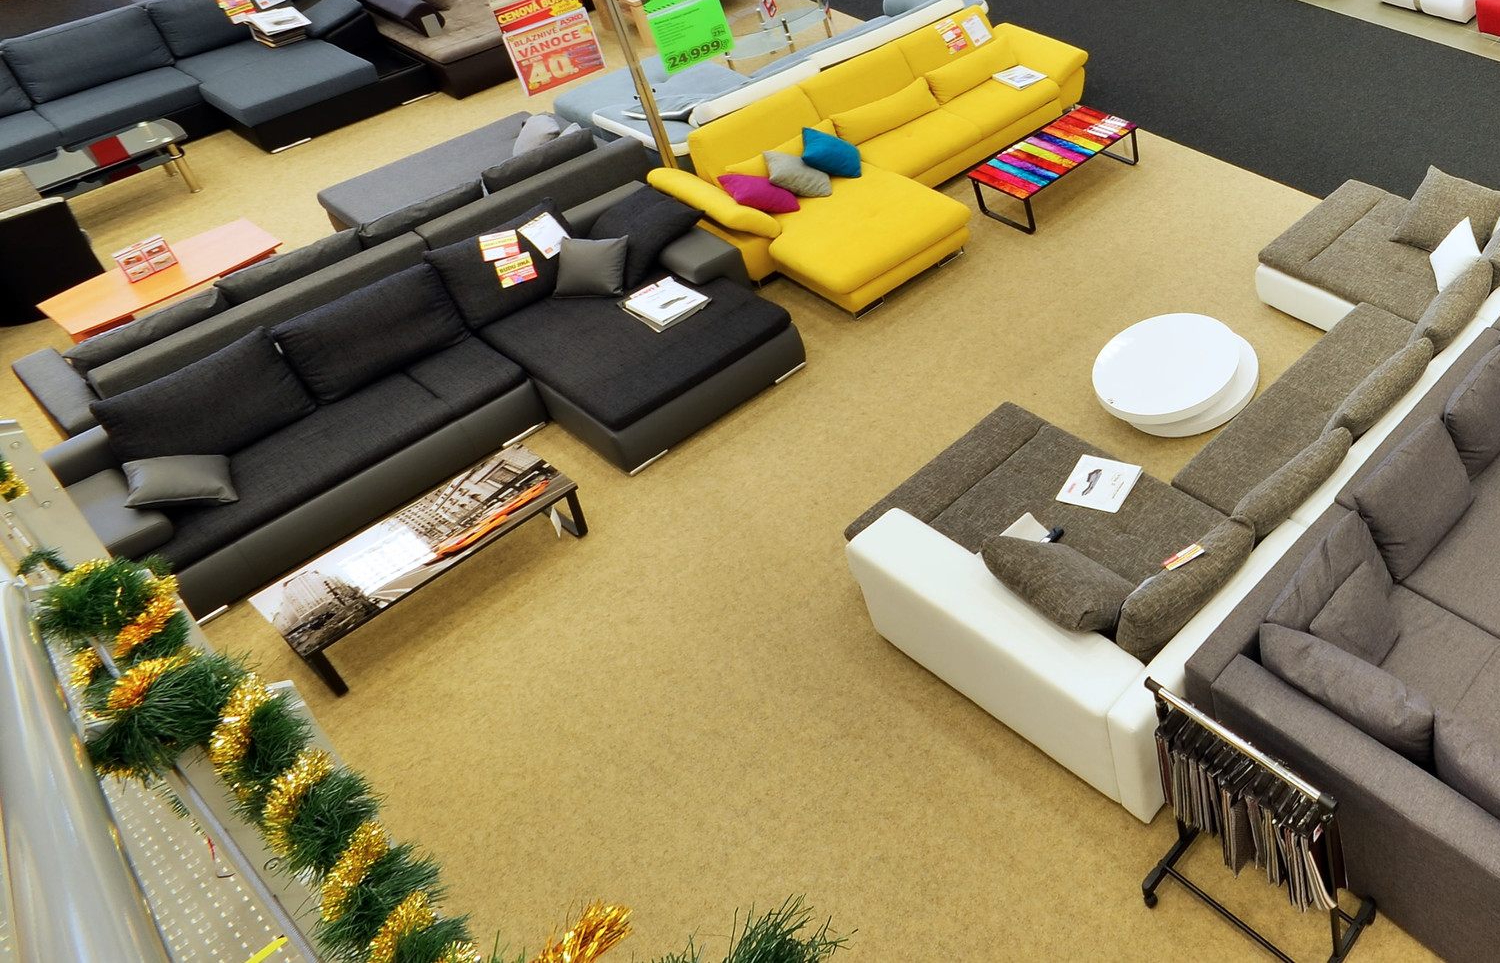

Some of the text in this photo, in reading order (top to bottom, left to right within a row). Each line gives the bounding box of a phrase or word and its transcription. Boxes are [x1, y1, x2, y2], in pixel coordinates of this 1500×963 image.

[498, 1, 541, 24] CENOVÁ
[560, 13, 584, 26] ASKO
[513, 27, 558, 48] BLÁZNIVÉ
[518, 29, 582, 58] VÁNOCE
